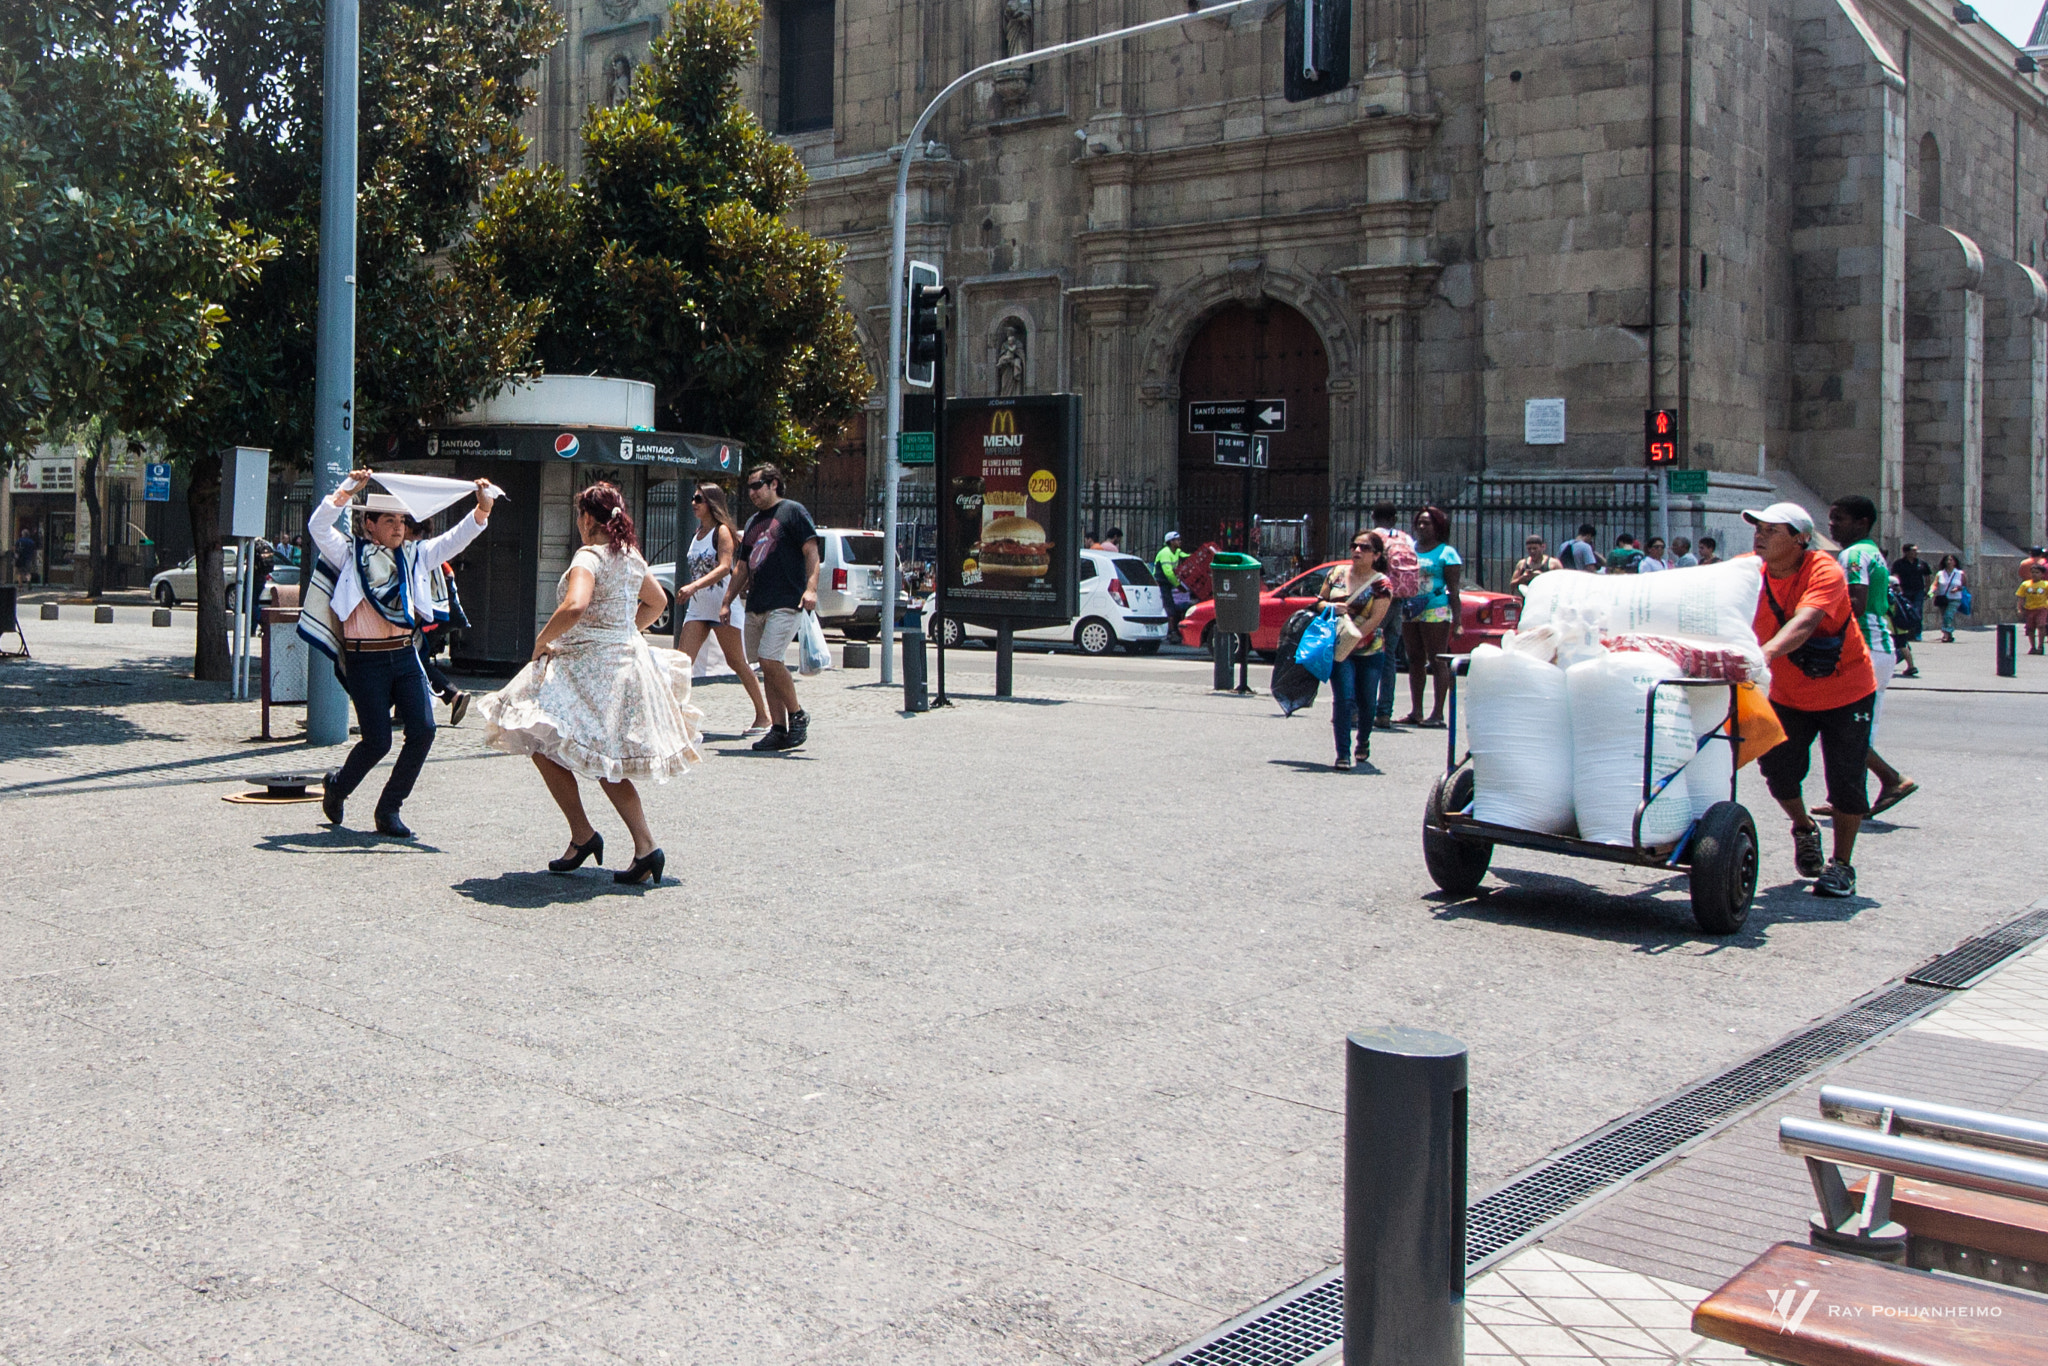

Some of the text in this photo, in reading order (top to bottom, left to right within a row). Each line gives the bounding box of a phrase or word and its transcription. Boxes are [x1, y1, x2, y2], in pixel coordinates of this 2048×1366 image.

[1194, 406, 1245, 415] SANTO DOMINGO
[441, 440, 481, 448] SANTIAGO
[983, 434, 1023, 448] MENU
[462, 448, 512, 457] Municipalidad
[636, 444, 675, 455] SANTIAGO
[1650, 442, 1674, 461] 57
[635, 453, 698, 465] Ilustre Municipalidad
